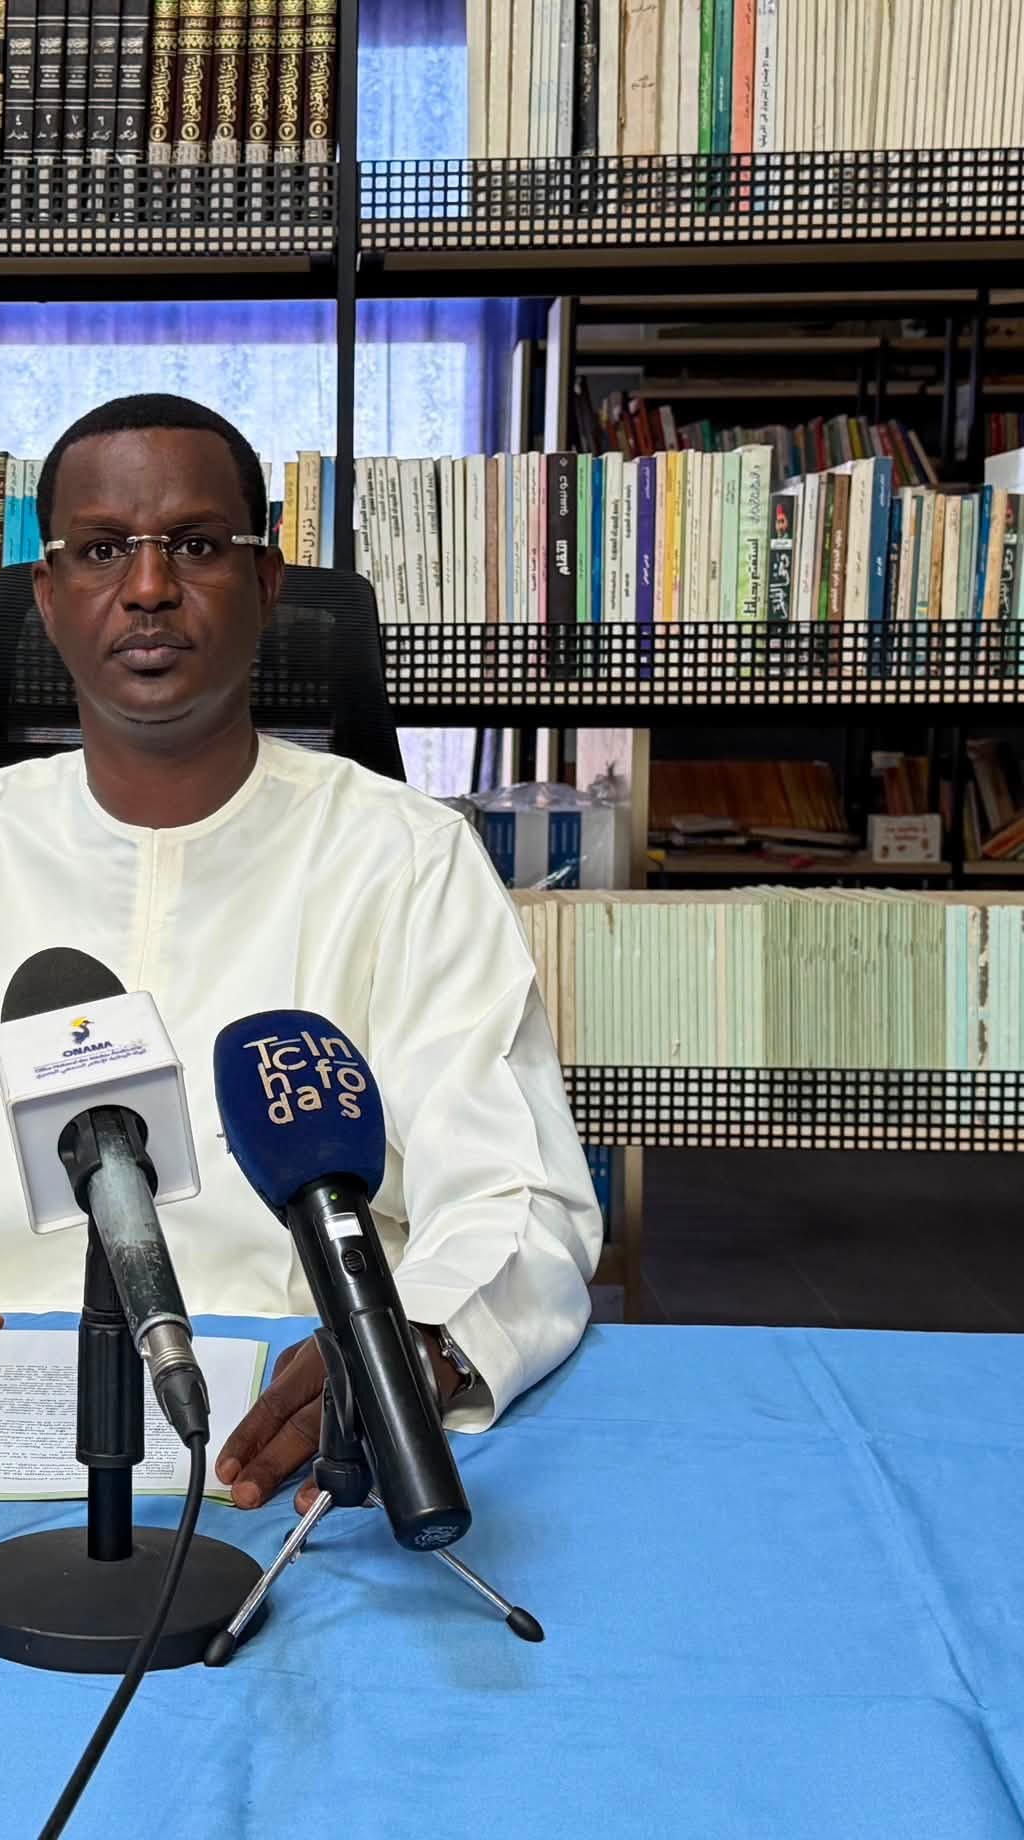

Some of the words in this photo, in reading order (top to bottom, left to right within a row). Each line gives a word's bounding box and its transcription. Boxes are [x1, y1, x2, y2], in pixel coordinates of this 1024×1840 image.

[303, 518, 315, 546] نزول
[834, 530, 843, 547] جنوب
[556, 540, 571, 576] انتقام
[747, 539, 760, 579] استمتع
[833, 549, 841, 571] الحدود
[830, 588, 839, 613] الشمس
[63, 1041, 112, 1057] ONAMA
